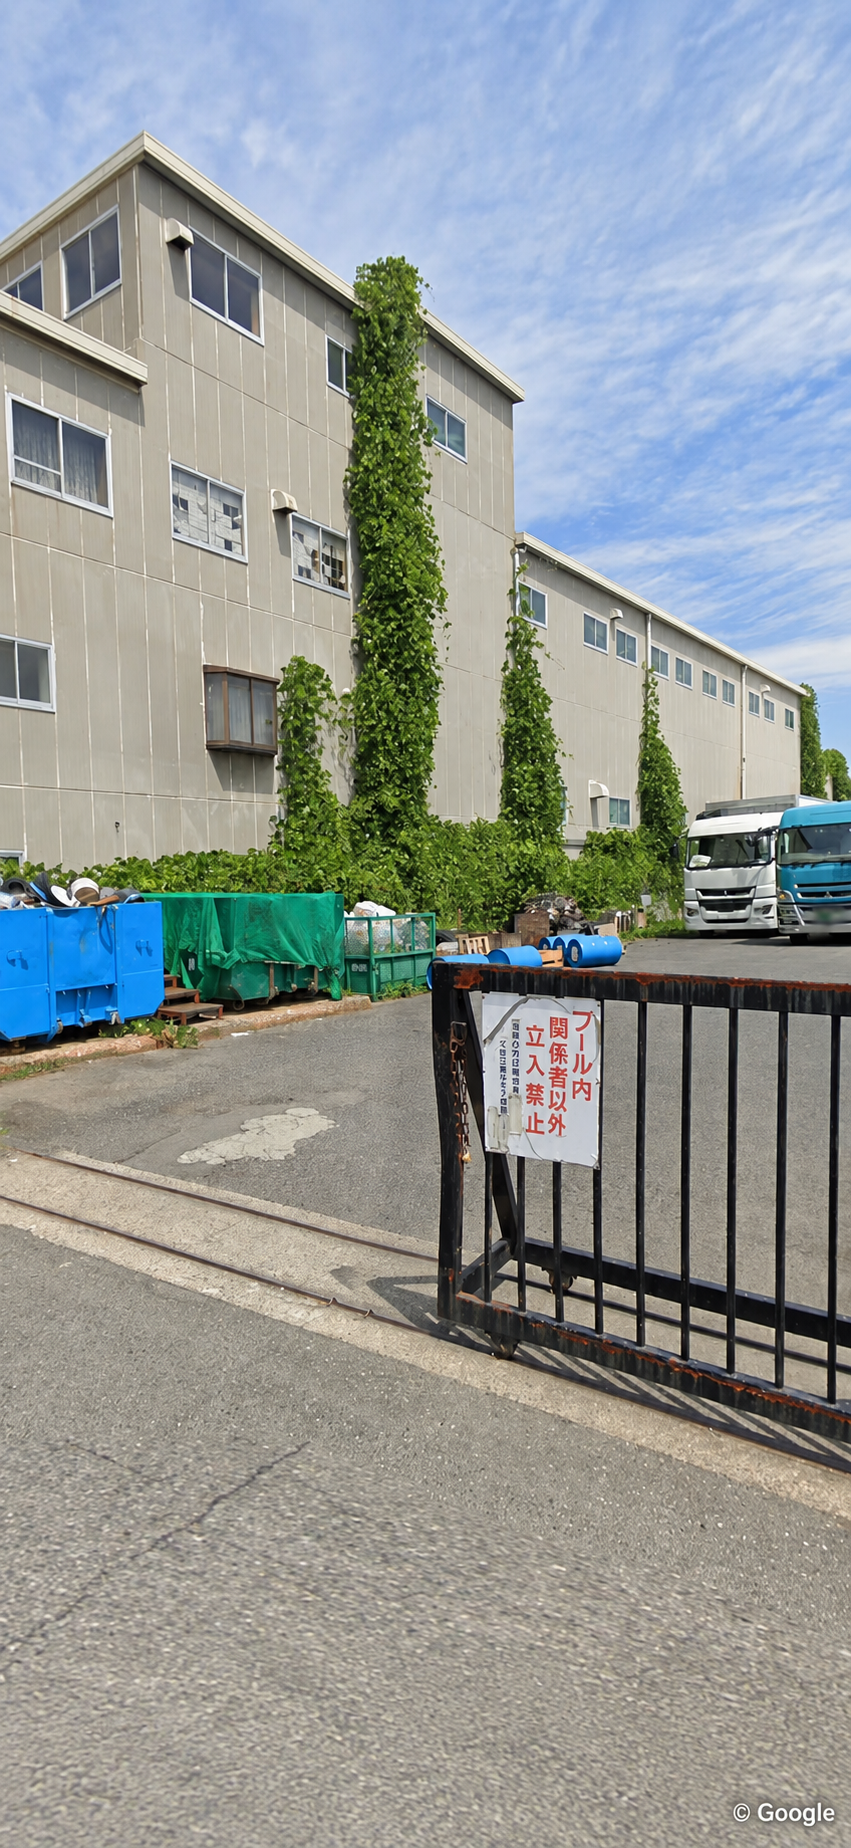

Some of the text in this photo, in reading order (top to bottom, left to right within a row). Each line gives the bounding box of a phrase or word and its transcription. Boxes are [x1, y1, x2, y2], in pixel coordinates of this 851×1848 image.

[525, 1024, 545, 1135] 立入禁止
[548, 1016, 569, 1136] 関係者以外
